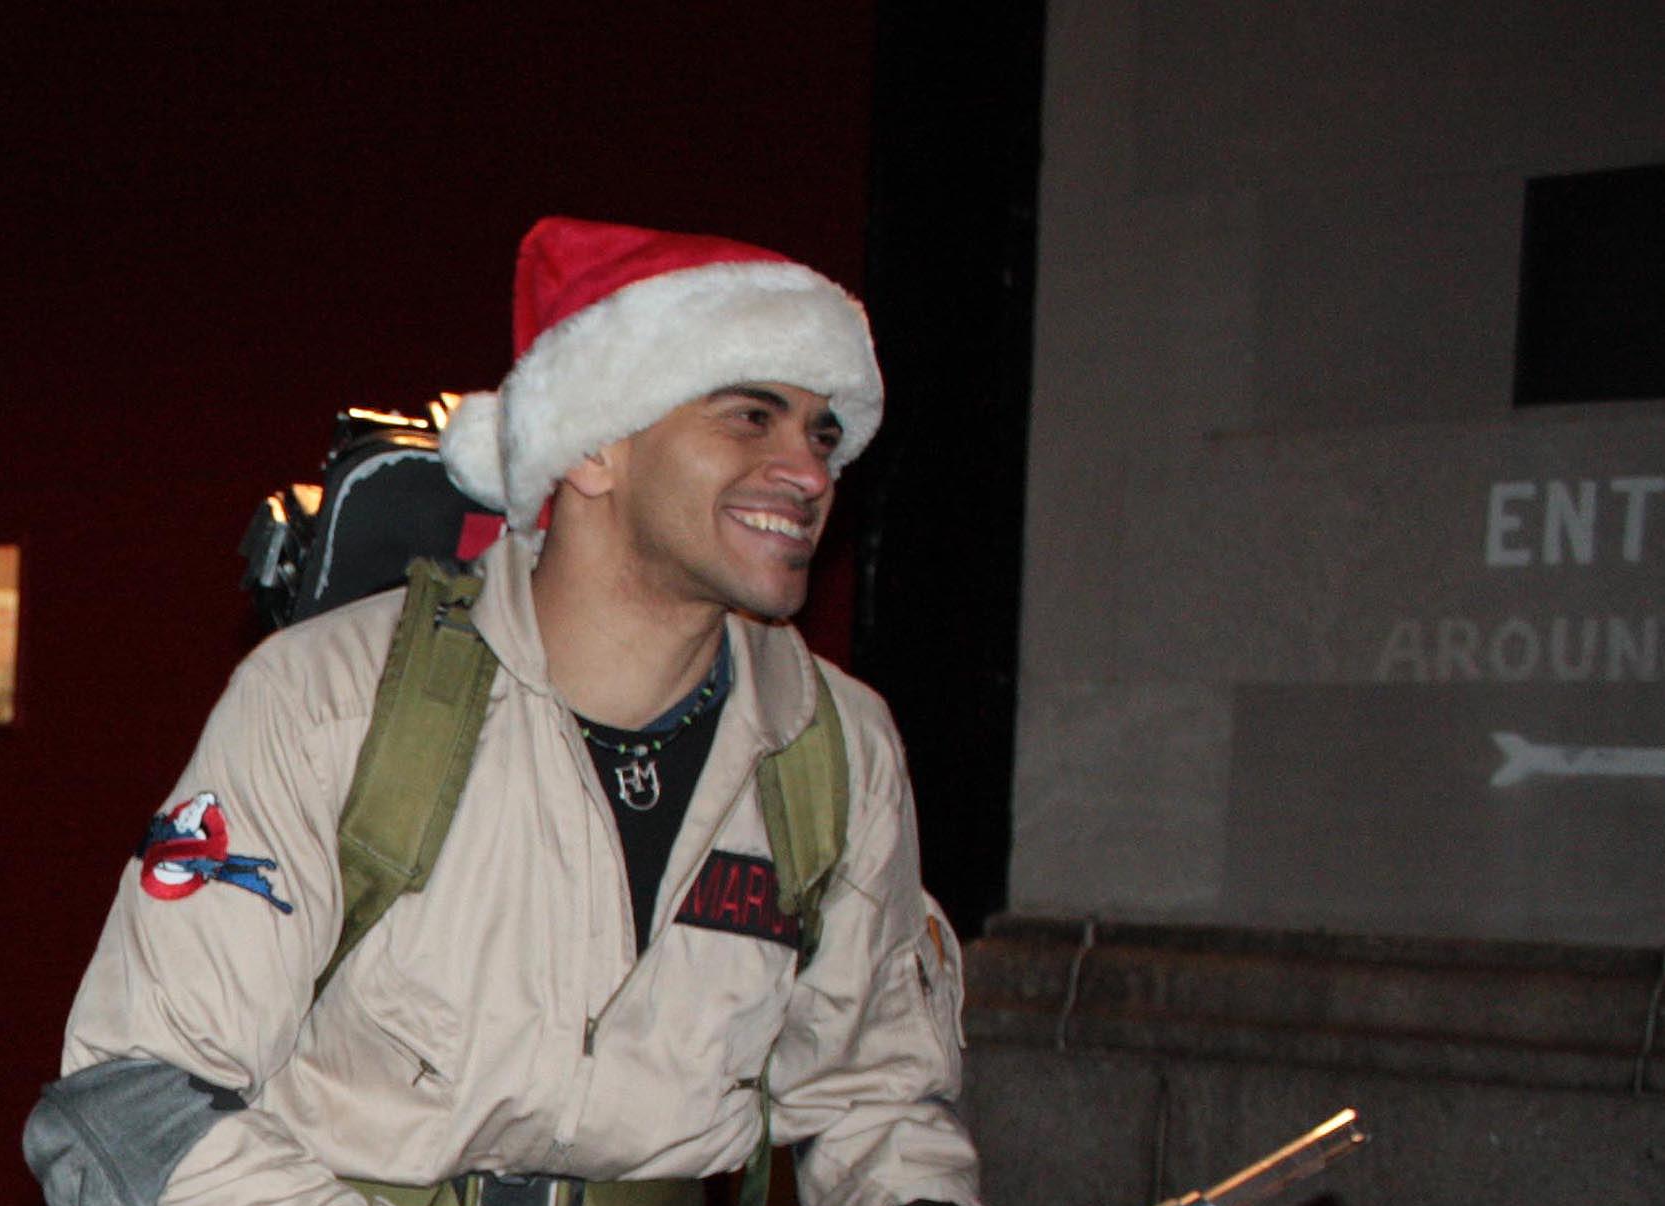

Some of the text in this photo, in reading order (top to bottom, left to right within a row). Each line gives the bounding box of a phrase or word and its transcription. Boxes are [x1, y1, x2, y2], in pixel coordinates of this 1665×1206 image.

[1485, 476, 1665, 566] ENT
[1377, 617, 1658, 682] AROUN
[678, 858, 786, 936] MAR
